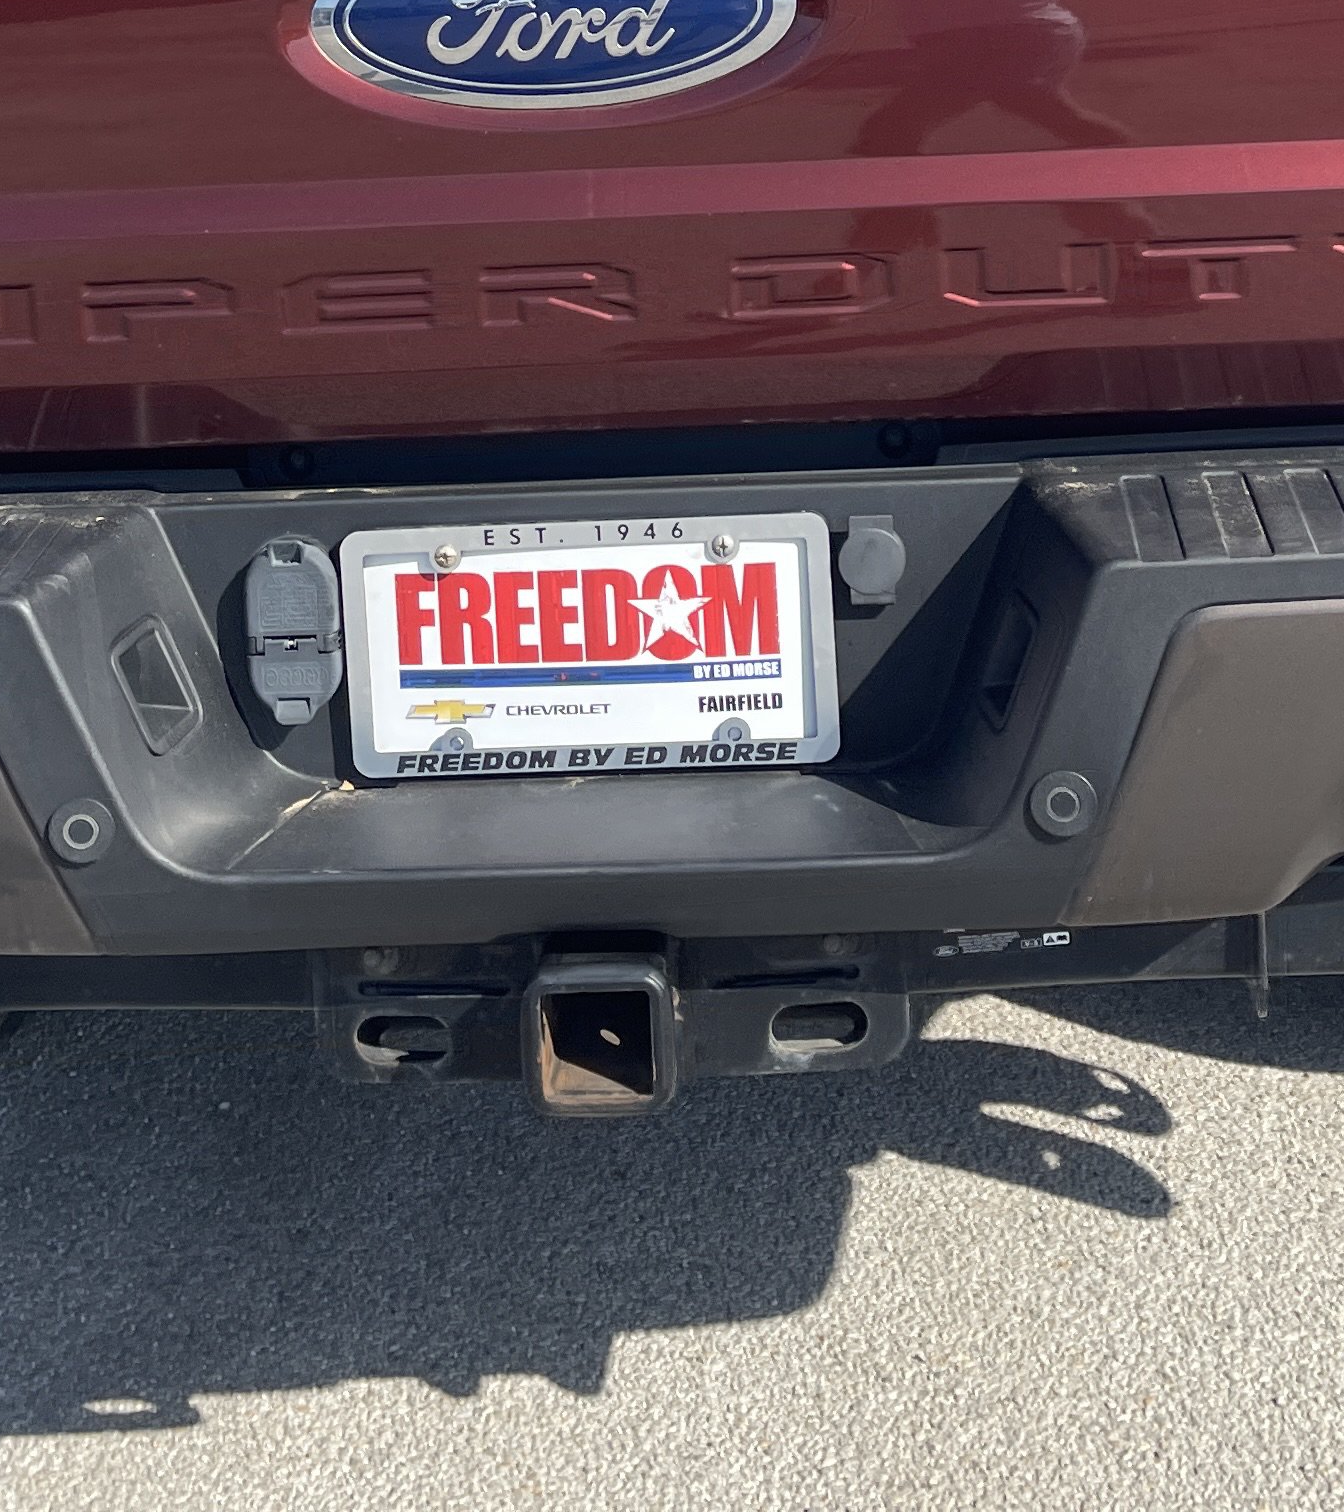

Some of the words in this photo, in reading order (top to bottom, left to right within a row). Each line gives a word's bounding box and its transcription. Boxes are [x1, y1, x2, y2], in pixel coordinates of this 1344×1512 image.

[483, 527, 564, 546] EST.
[594, 521, 684, 541] 1946
[394, 561, 781, 666] FREEDOM
[692, 663, 712, 679] BY
[714, 663, 732, 678] ED
[733, 662, 780, 677] MORSE
[505, 703, 611, 717] CHEVROLET
[697, 692, 783, 714] FAIRFIELD
[396, 749, 556, 774] FREEDOM
[567, 747, 616, 768] BY
[623, 745, 669, 766] ED
[680, 742, 798, 764] MORSE
